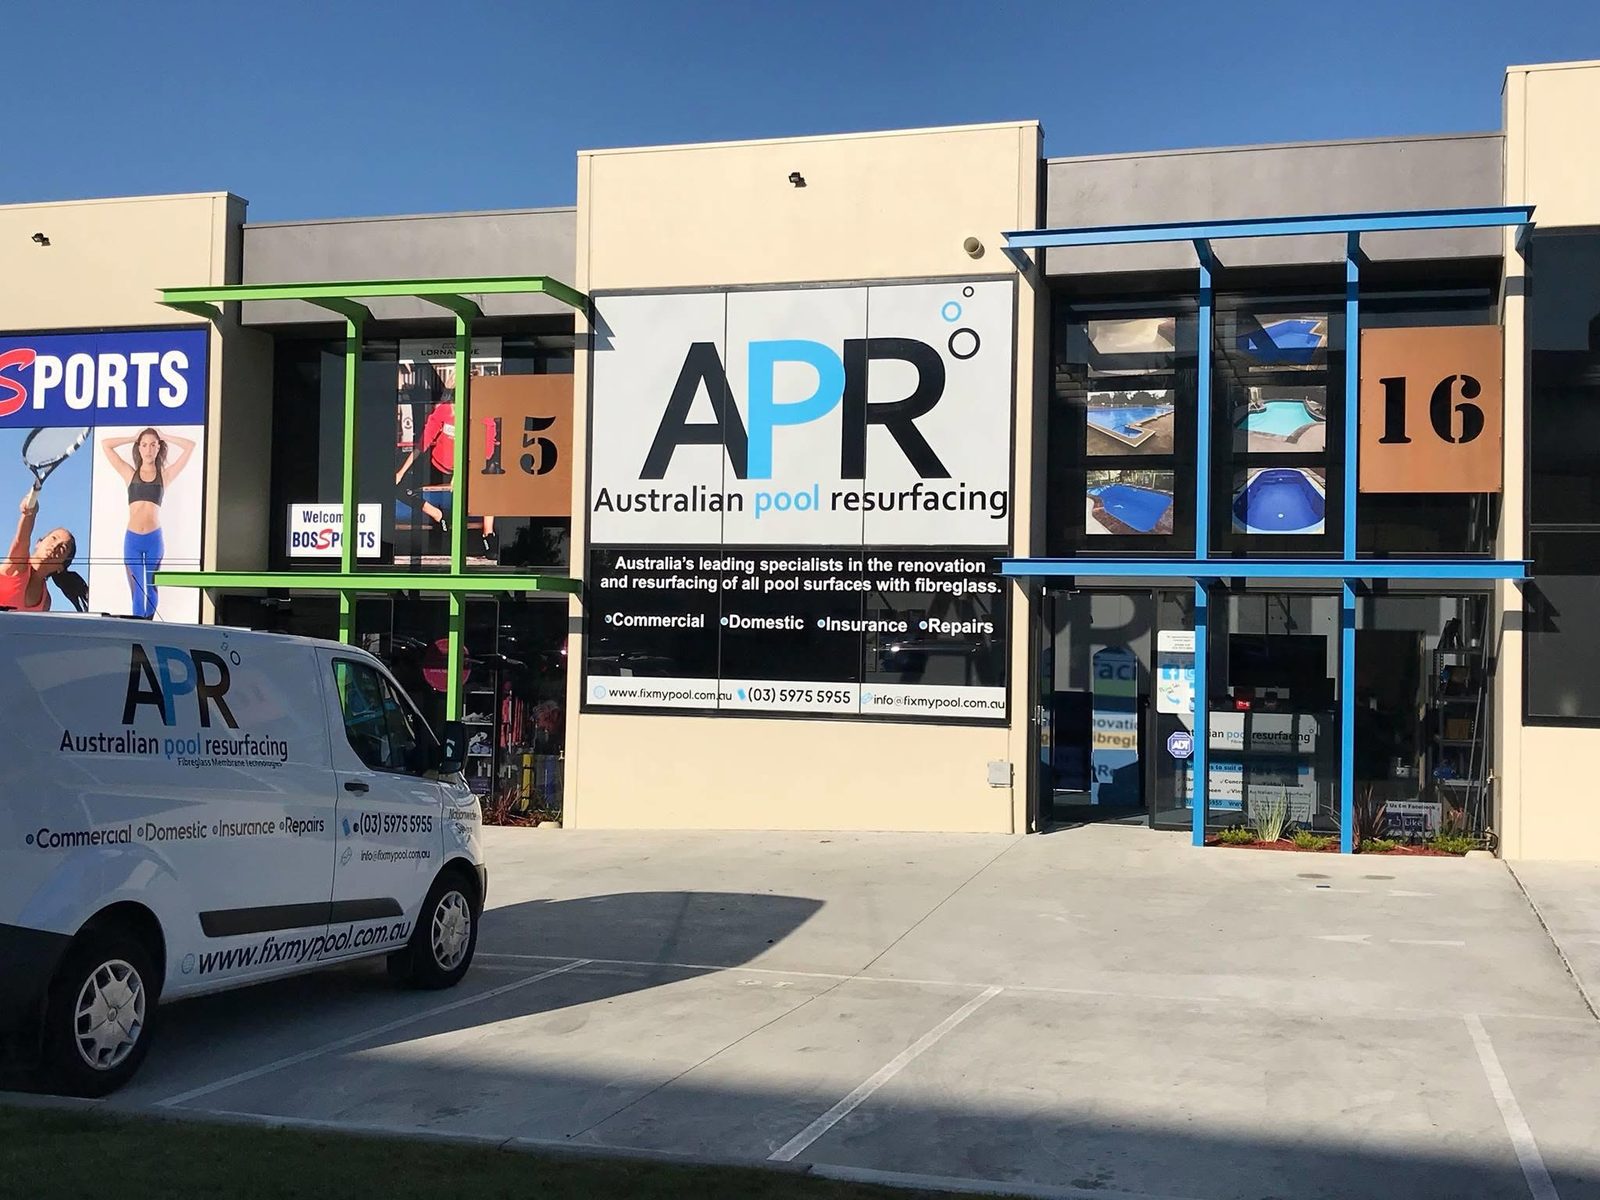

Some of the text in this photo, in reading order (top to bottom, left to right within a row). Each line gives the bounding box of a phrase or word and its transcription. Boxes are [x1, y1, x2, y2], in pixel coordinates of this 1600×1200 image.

[0, 348, 189, 417] SPORTS
[638, 337, 953, 480] APR
[1378, 374, 1485, 445] 16
[480, 416, 559, 476] 15
[593, 482, 1009, 520] Australian pool resurfacing
[302, 510, 345, 524] Welcom
[292, 528, 375, 550] BOSSPTS
[614, 556, 986, 574] Australia's leading specialists in the renovation
[600, 575, 1002, 597] and resurfacing of all pool surfaces with fibreglass.
[612, 612, 994, 637] Commercial Domestic Insurance Repairs
[121, 642, 240, 729] APR
[608, 687, 1006, 710] www.fixmypool.com.au (03) 5975 5955 info@fixmypool.com.au
[59, 729, 288, 762] Australian pool resurfacing
[1171, 740, 1189, 750] ADT
[1252, 731, 1311, 744] resurfacing
[177, 757, 211, 769] Fibreglass
[211, 758, 245, 768] Membrane
[36, 824, 132, 849] Commercial
[145, 820, 208, 841] Domestic
[219, 819, 276, 838] Insurance
[284, 815, 325, 837] Repairs
[360, 812, 382, 836] (03)
[383, 814, 408, 834] 5975
[410, 814, 433, 833] 5955
[360, 849, 431, 864] info@fixmypool.com.au
[199, 921, 412, 975] www.fixmypool.com.au
